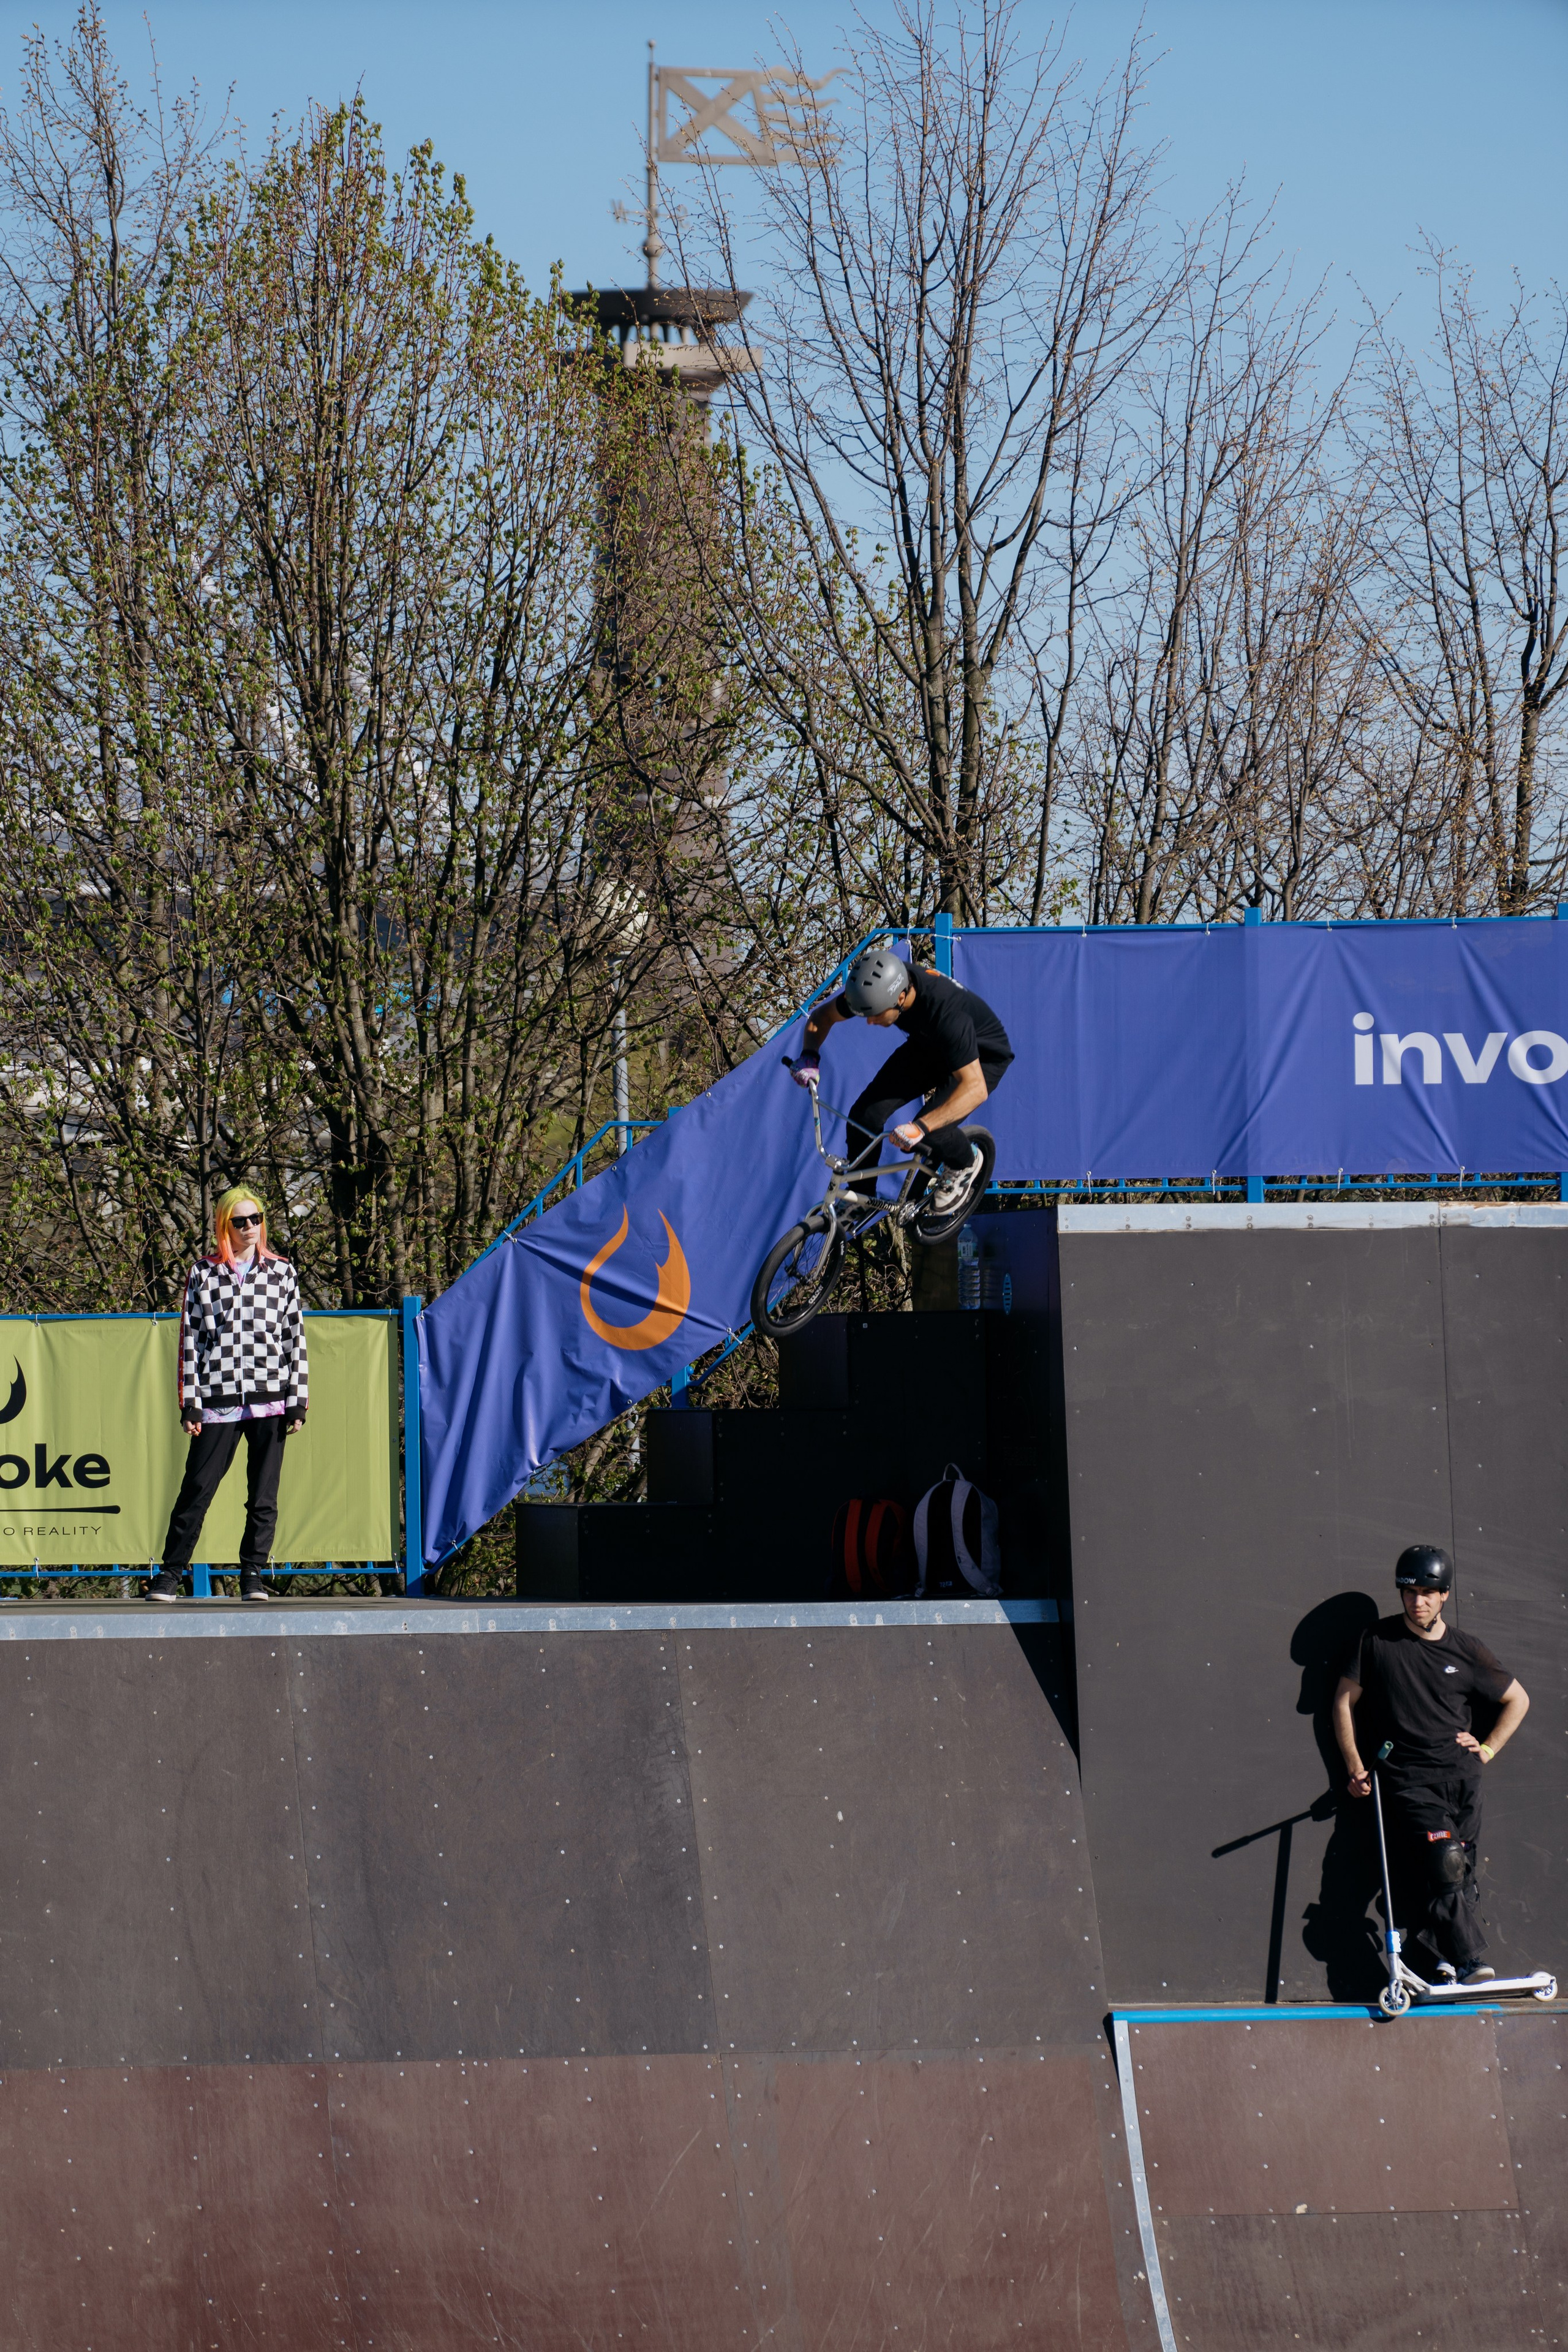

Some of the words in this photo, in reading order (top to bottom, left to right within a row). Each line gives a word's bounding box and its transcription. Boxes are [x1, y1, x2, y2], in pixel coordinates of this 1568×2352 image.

[1352, 1011, 1568, 1085] invo
[0, 1443, 111, 1489] oke
[3, 1527, 15, 1536] O
[23, 1526, 102, 1536] REALITY
